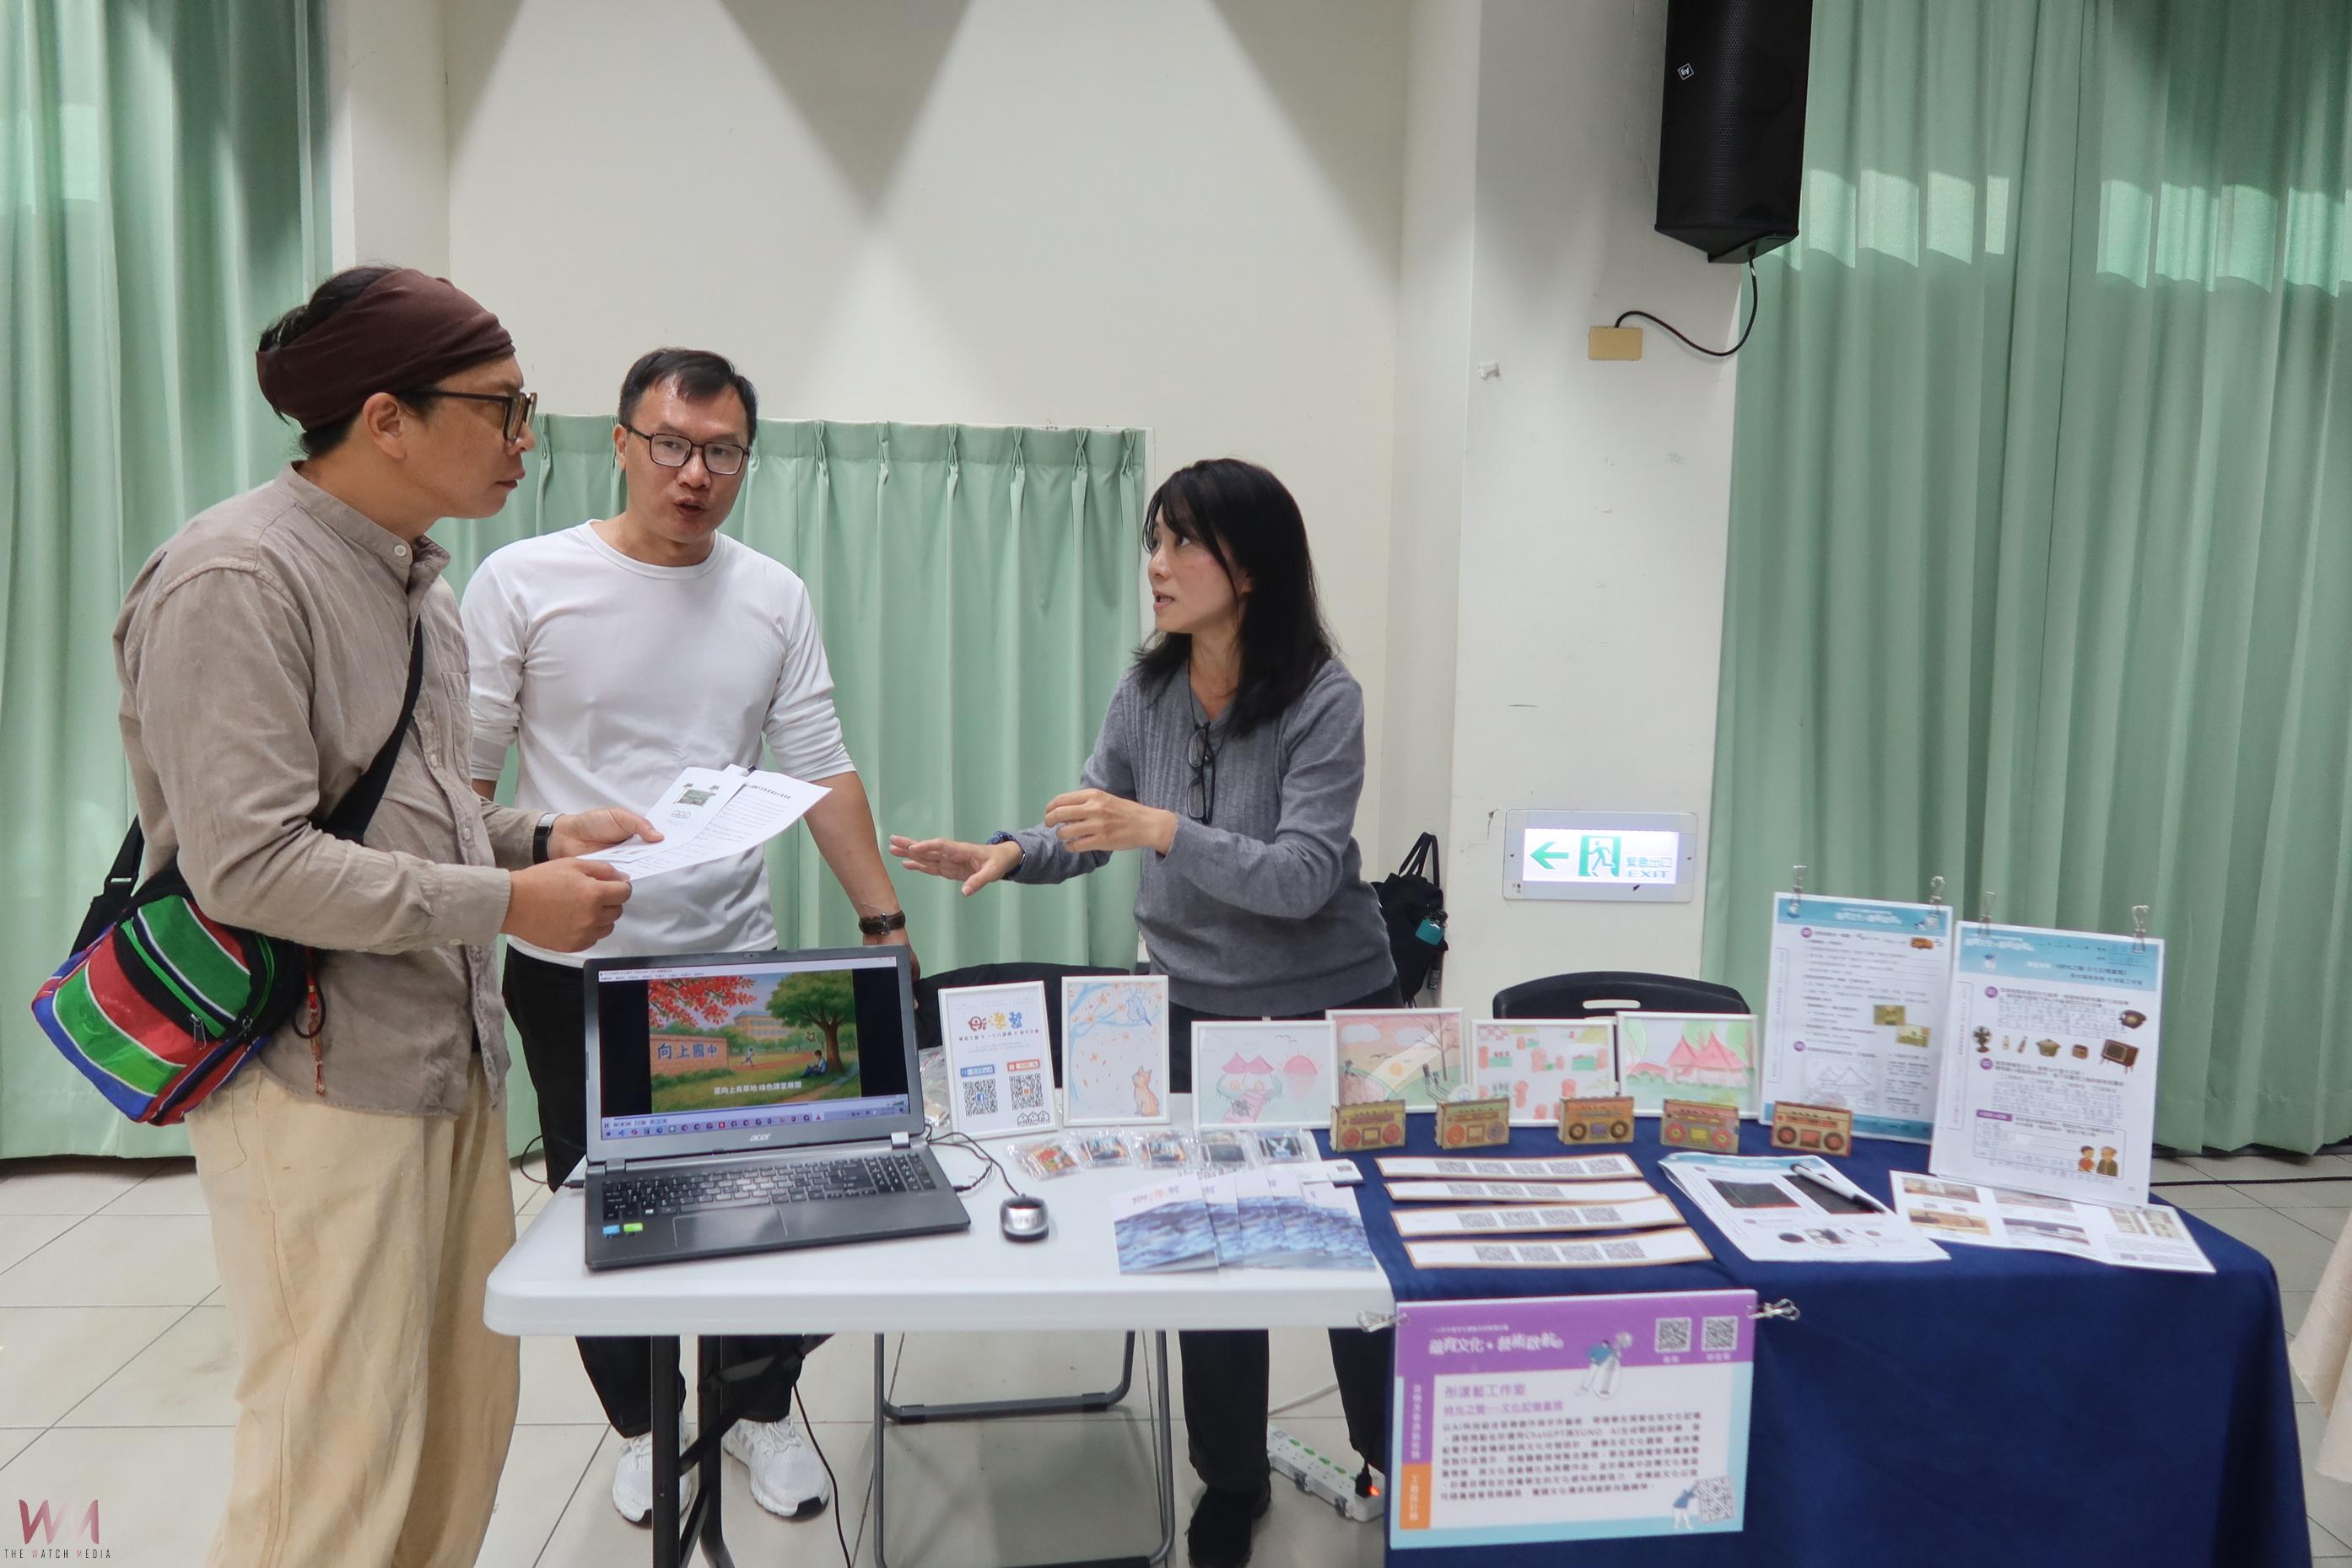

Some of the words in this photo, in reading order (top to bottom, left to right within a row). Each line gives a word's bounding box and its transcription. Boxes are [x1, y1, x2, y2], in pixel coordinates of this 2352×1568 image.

[1628, 870, 1670, 879] EXIT
[656, 1042, 718, 1060] 向上國中
